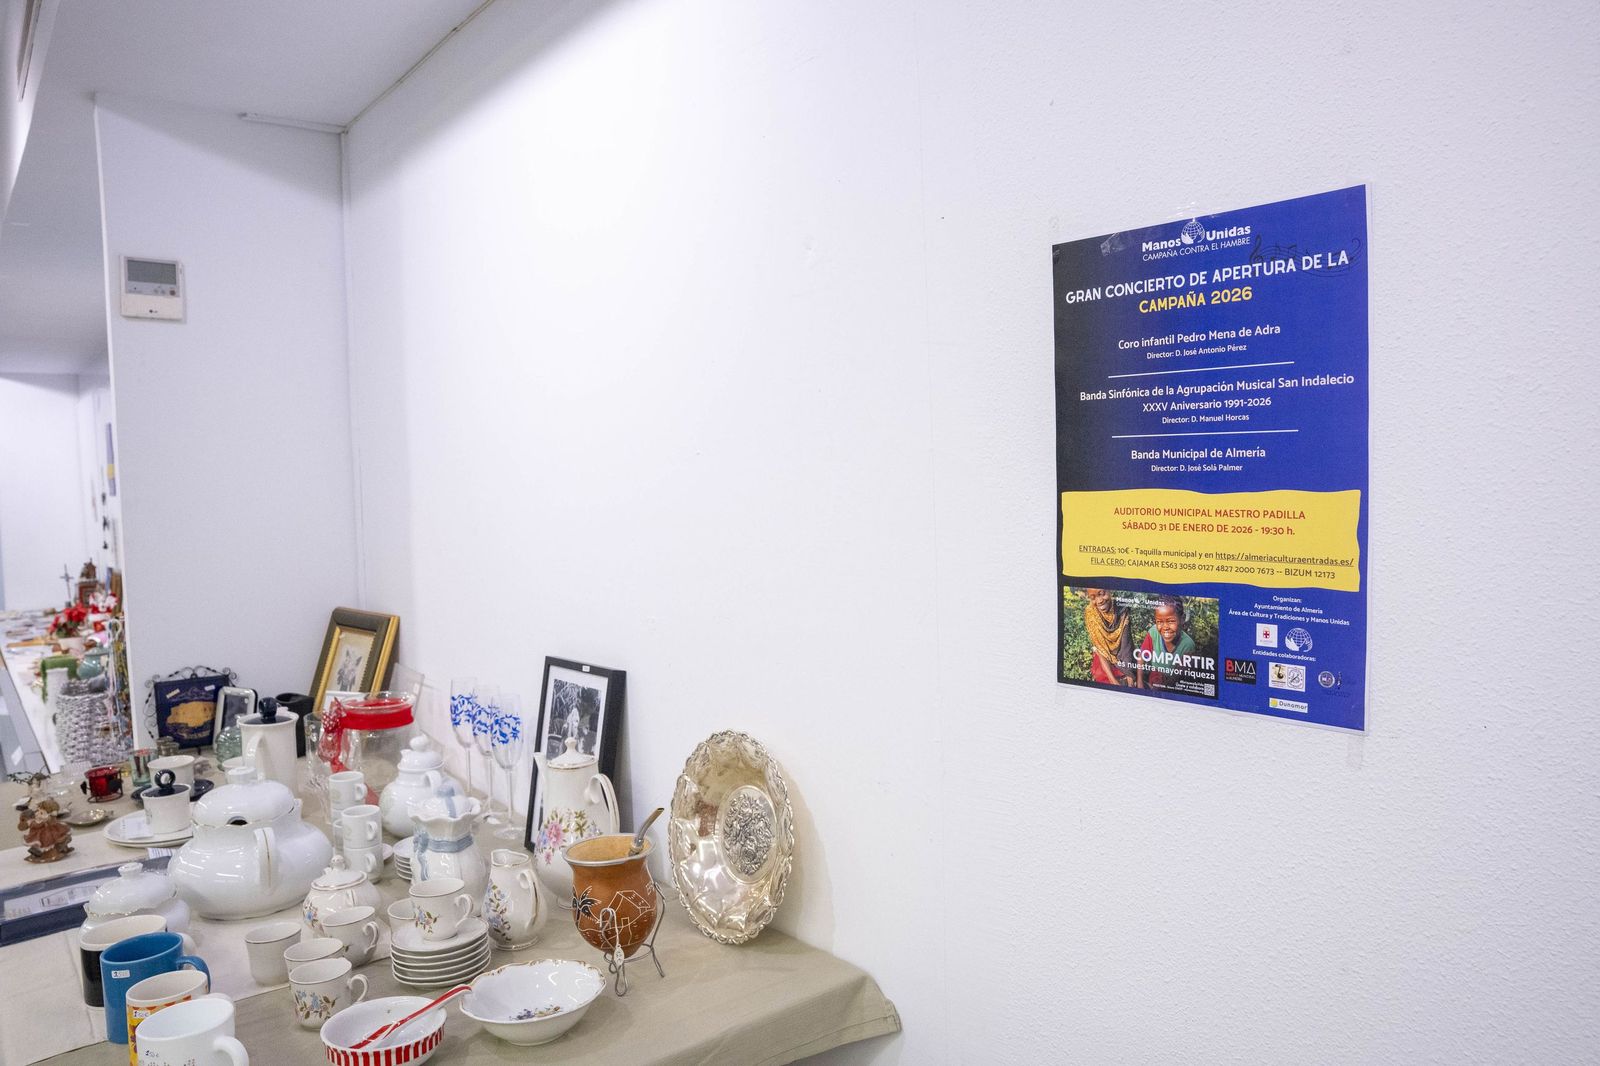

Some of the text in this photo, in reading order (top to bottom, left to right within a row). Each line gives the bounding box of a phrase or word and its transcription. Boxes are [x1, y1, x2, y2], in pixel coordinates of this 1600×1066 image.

[1142, 225, 1250, 252] Manos Unidas
[1142, 238, 1250, 261] CAMPAÑA CONTRA EL HAMBRE
[1066, 250, 1348, 304] GRAN CONCIERTO DE APERTURA DE LA
[1139, 286, 1252, 313] CAMPAÑA 2026
[1119, 324, 1280, 350] Coro infantil Pedro Mena de Adra
[1147, 350, 1174, 359] Director:
[1183, 347, 1197, 357] José
[1199, 345, 1226, 355] Antonio
[1228, 343, 1247, 352] Pérez
[1080, 373, 1354, 401] Banda Sinfónica de la Agrupación Musical San Indalecio
[1143, 397, 1271, 412] XXXV Aniversario 1991-2026
[1191, 415, 1198, 423] D.
[1200, 414, 1223, 422] Manuel
[1131, 447, 1265, 461] Banda Municipal de Almería
[1188, 463, 1201, 472] José
[1114, 507, 1305, 520] AUDITORIO MUNICIPAL MAESTRO PADILLA
[1122, 520, 1156, 530] SÁBADO
[1159, 523, 1166, 532] 31
[1169, 523, 1180, 531] DE
[1183, 523, 1214, 532] ENERO
[1216, 524, 1229, 533] DE
[1231, 525, 1252, 534] 2026
[1261, 526, 1283, 535] 19:30
[1286, 526, 1295, 535] h.
[1079, 545, 1116, 554] ENTRADAS:
[1135, 548, 1161, 557] Taquilla
[1163, 549, 1197, 559] municipal
[1216, 551, 1353, 567] https://almeriaculturaentradas.es/
[1091, 557, 1104, 565] FILA
[1106, 557, 1126, 566] CERO:
[1128, 559, 1159, 568] CAJAMAR
[1161, 561, 1177, 569] ES63
[1198, 563, 1214, 571] 0127
[1216, 565, 1233, 573] 4827
[1235, 566, 1255, 574] 2000
[1257, 567, 1274, 575] 7673
[1285, 569, 1312, 577] BIZUM
[1314, 570, 1335, 579] 12173
[1254, 603, 1292, 611] Ayuntamiento
[1274, 614, 1305, 622] Tradiciones
[1133, 649, 1215, 670] COMPARTIR
[1253, 649, 1316, 661] Entidades colaboradoras:
[1128, 662, 1155, 671] nuestra
[1158, 667, 1182, 675] mayor
[1185, 669, 1215, 680] riqueza
